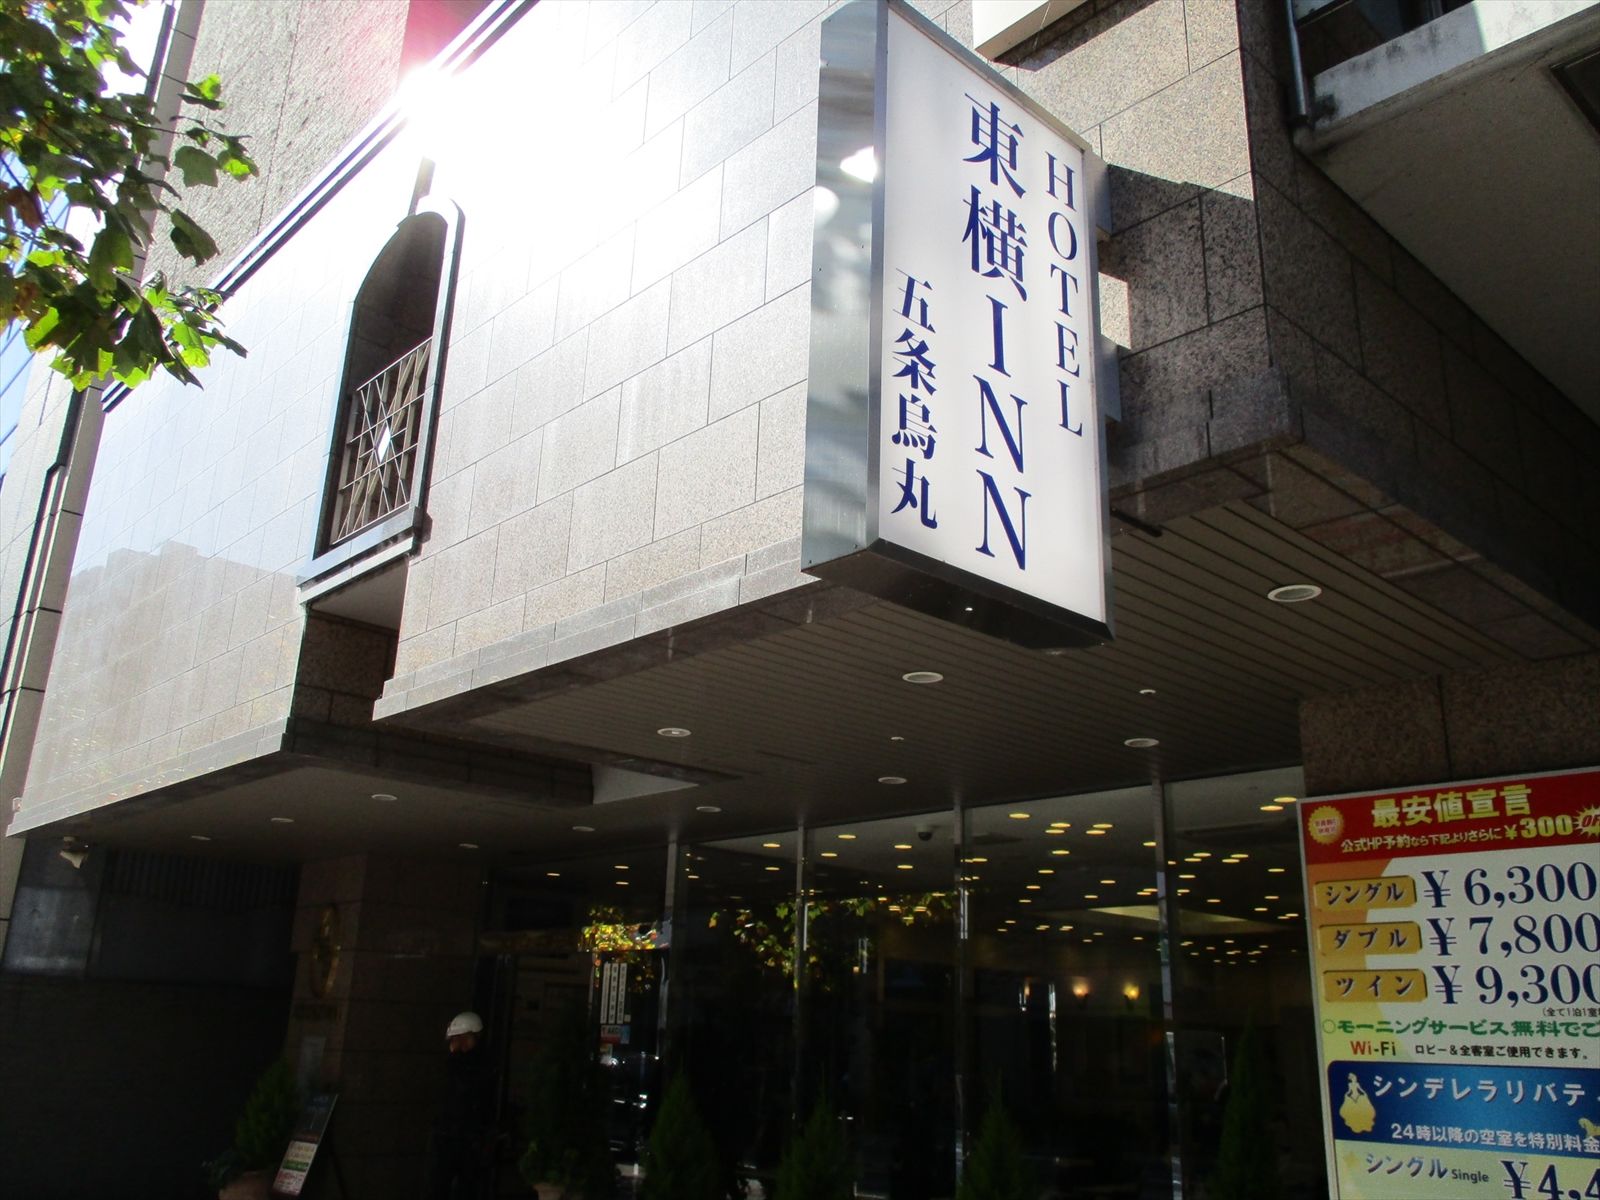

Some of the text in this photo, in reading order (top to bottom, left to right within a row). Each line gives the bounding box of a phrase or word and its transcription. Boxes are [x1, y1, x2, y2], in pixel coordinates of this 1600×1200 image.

[1044, 152, 1084, 437] HOTEL
[890, 267, 938, 530] 五条烏丸
[1371, 784, 1532, 828] 最安値宣言
[1326, 883, 1405, 906] シングル
[1334, 928, 1407, 950] ダブル
[1337, 975, 1415, 996] ツイン
[1542, 1007, 1600, 1018] (全て1泊1室
[1350, 1040, 1397, 1057] Wi-Fi
[1372, 1074, 1600, 1106] シンデレラリバテ
[1366, 1154, 1448, 1179] シングル
[1451, 1168, 1489, 1184] Single
